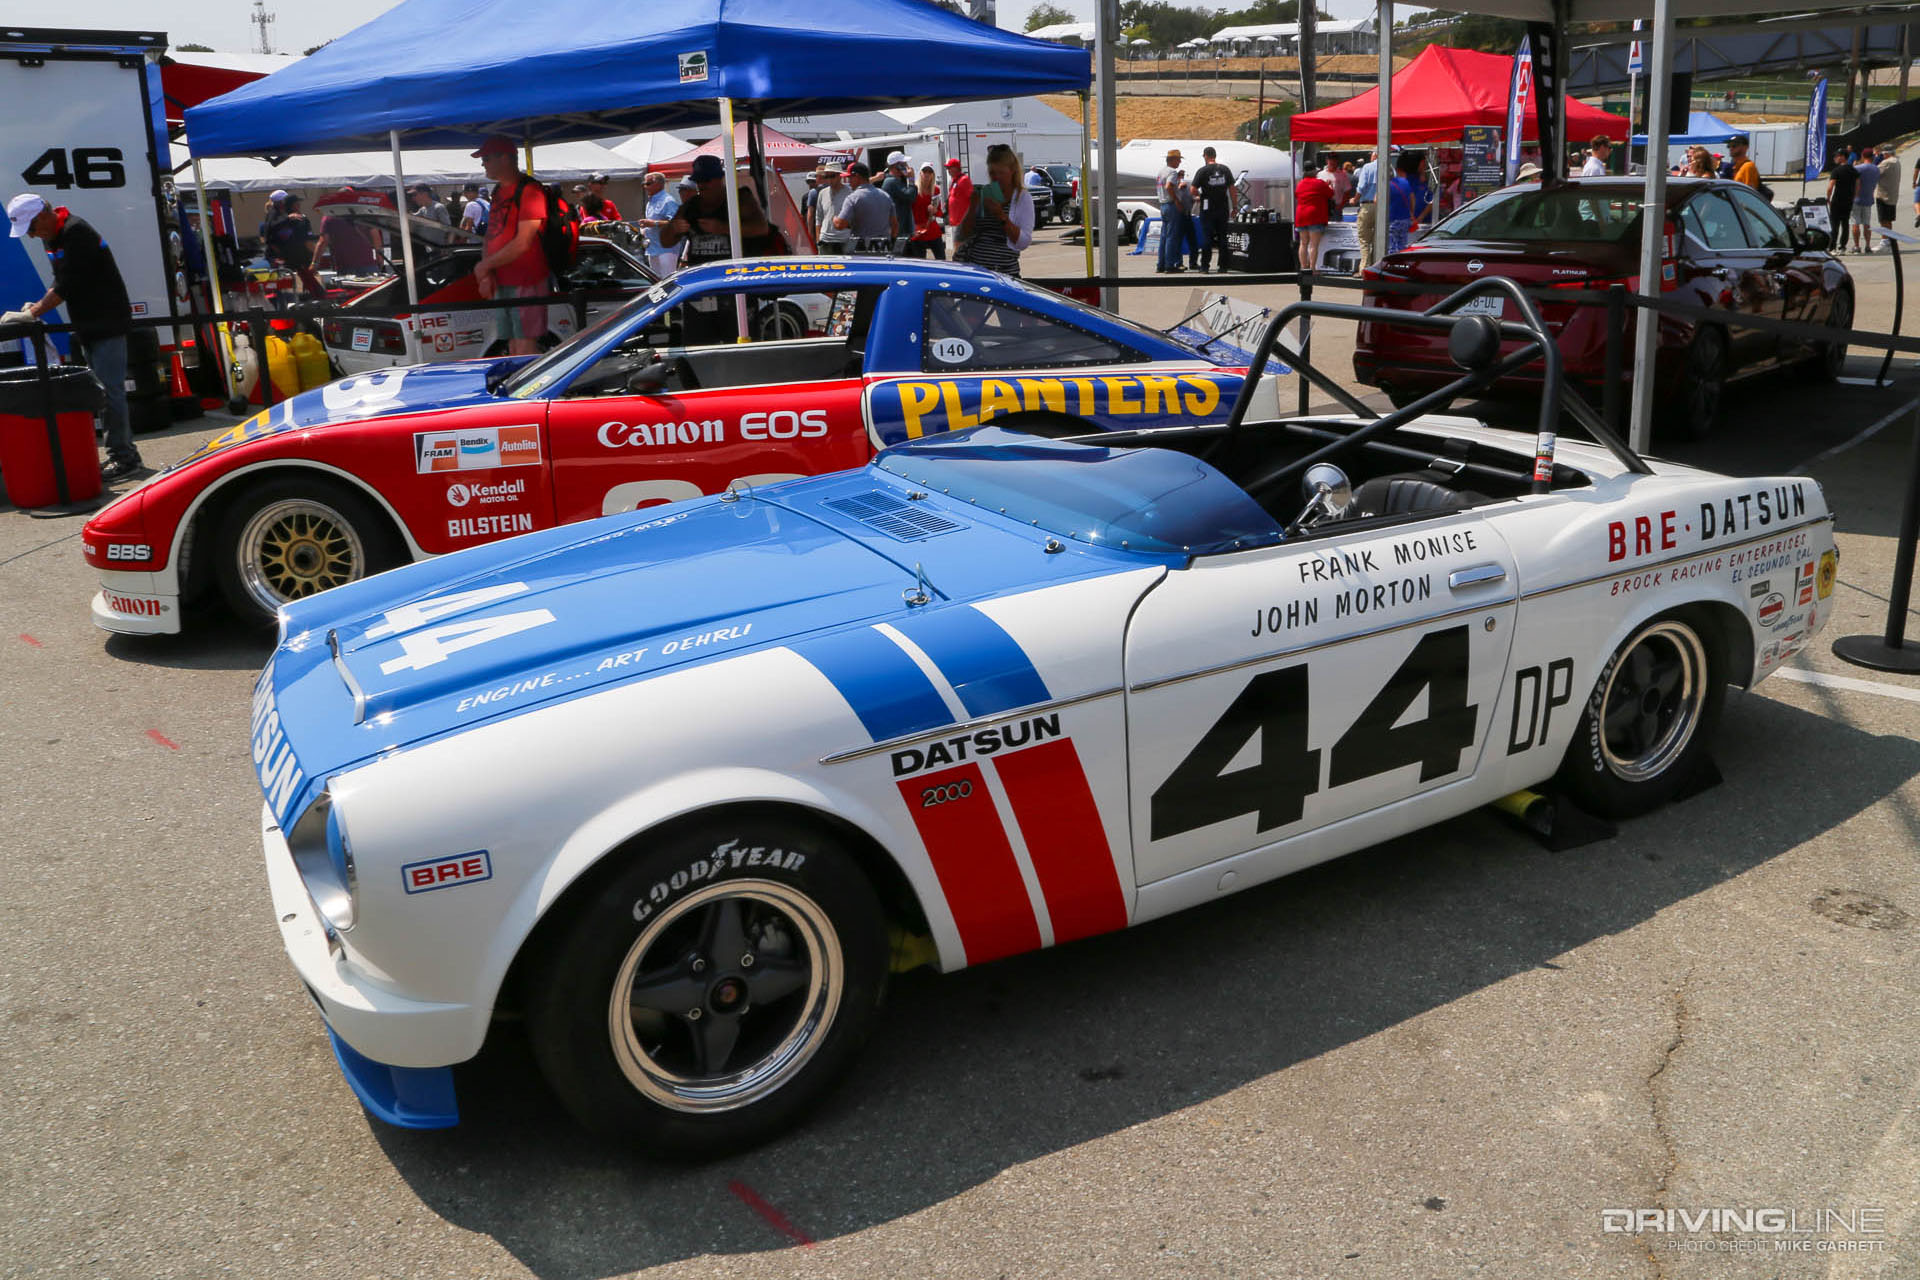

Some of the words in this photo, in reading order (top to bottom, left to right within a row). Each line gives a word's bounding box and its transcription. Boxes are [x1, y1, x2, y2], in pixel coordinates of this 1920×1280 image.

[779, 116, 810, 124] ROLEX
[21, 147, 126, 190] 46
[725, 264, 846, 275] PLANTERS
[1552, 269, 1588, 277] PLATINUM
[938, 344, 966, 358] 140
[896, 374, 1221, 440] PLANTERS
[460, 437, 489, 447] Bendix
[597, 419, 725, 448] Canon
[740, 410, 828, 440] EOS
[424, 448, 453, 458] FRAM
[500, 439, 537, 452] Autolite
[470, 479, 525, 497] Kendall
[480, 495, 506, 504] MOTOR
[448, 513, 533, 538] BILSTEIN
[106, 544, 151, 560] BBS
[1298, 550, 1380, 584] FRANK
[1393, 530, 1478, 565] MONISE
[1610, 571, 1663, 597] BROCK
[1670, 557, 1722, 582] RACING
[1729, 533, 1808, 568] ENTERPRISES
[1731, 568, 1743, 584] EL
[103, 590, 160, 616] Canon
[1251, 597, 1319, 637] JOHN
[1335, 573, 1432, 619] MORTON
[364, 581, 557, 676] 44
[596, 648, 649, 672] ART
[660, 623, 753, 655] OEHRLI
[1506, 657, 1574, 756] DP
[890, 713, 1062, 777] DATSUN
[1150, 624, 1479, 842] 44
[920, 779, 973, 808] 2000
[411, 858, 485, 887] BRE
[632, 839, 807, 923] GOODYEAR
